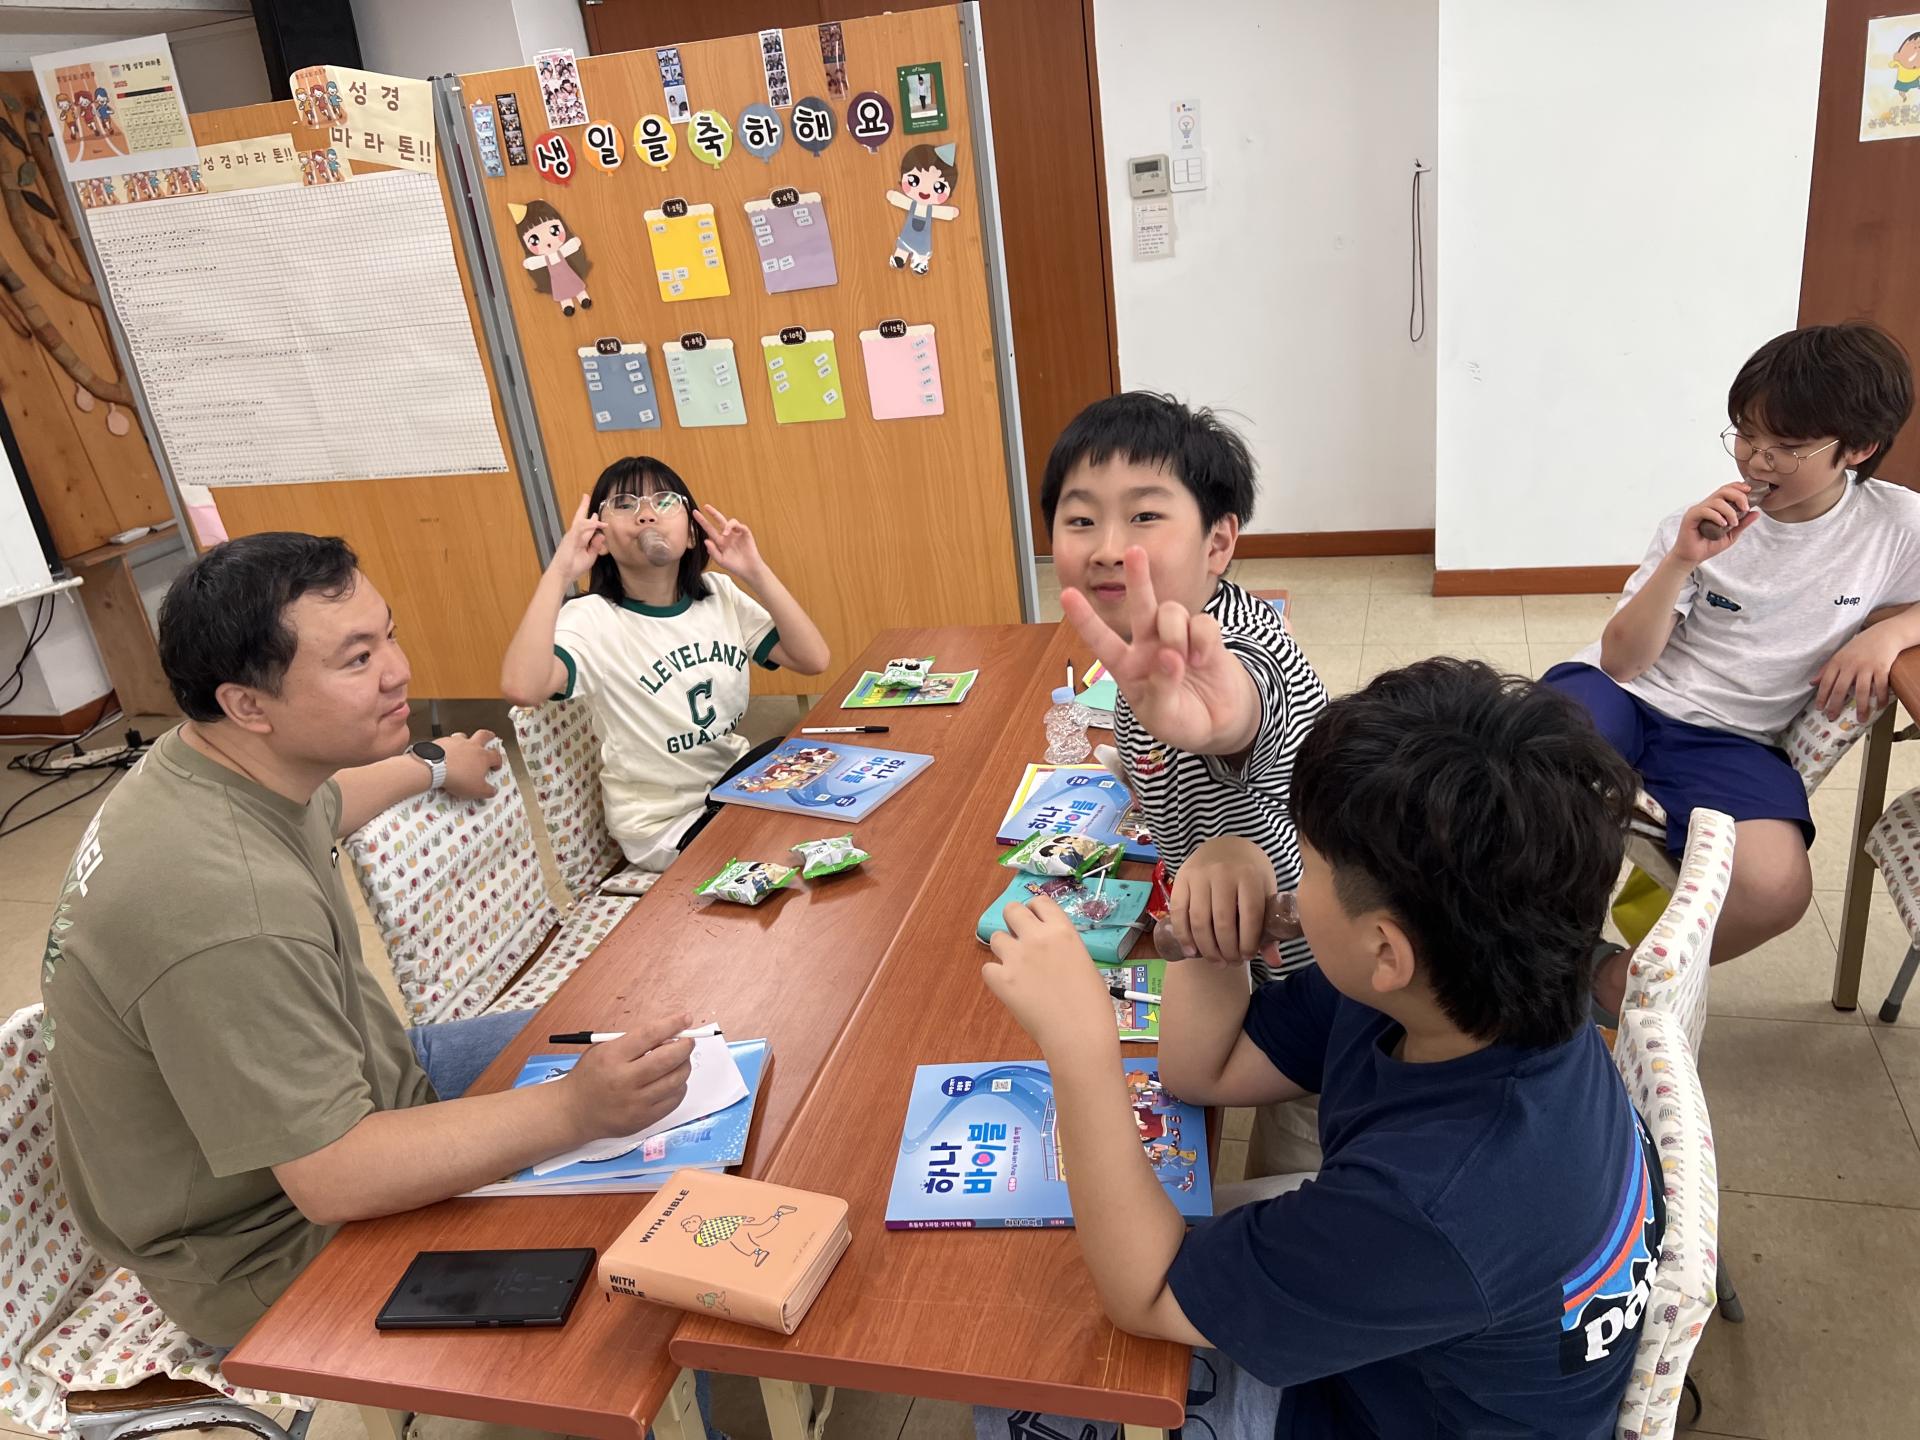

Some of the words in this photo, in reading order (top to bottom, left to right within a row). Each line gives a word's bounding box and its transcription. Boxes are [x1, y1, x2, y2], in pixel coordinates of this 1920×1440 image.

[1834, 595, 1861, 606] Jeep
[637, 640, 748, 697] LEVELAND
[686, 677, 717, 730] C
[839, 756, 889, 784] 바이블
[871, 759, 907, 779] 하나
[1027, 806, 1064, 829] 하나
[924, 1142, 963, 1194] 하나
[962, 1122, 1007, 1195] 바이블
[639, 1217, 666, 1244] WITH
[662, 1188, 691, 1219] BIBLE
[609, 1274, 636, 1288] WITH
[610, 1284, 646, 1299] BIBLE
